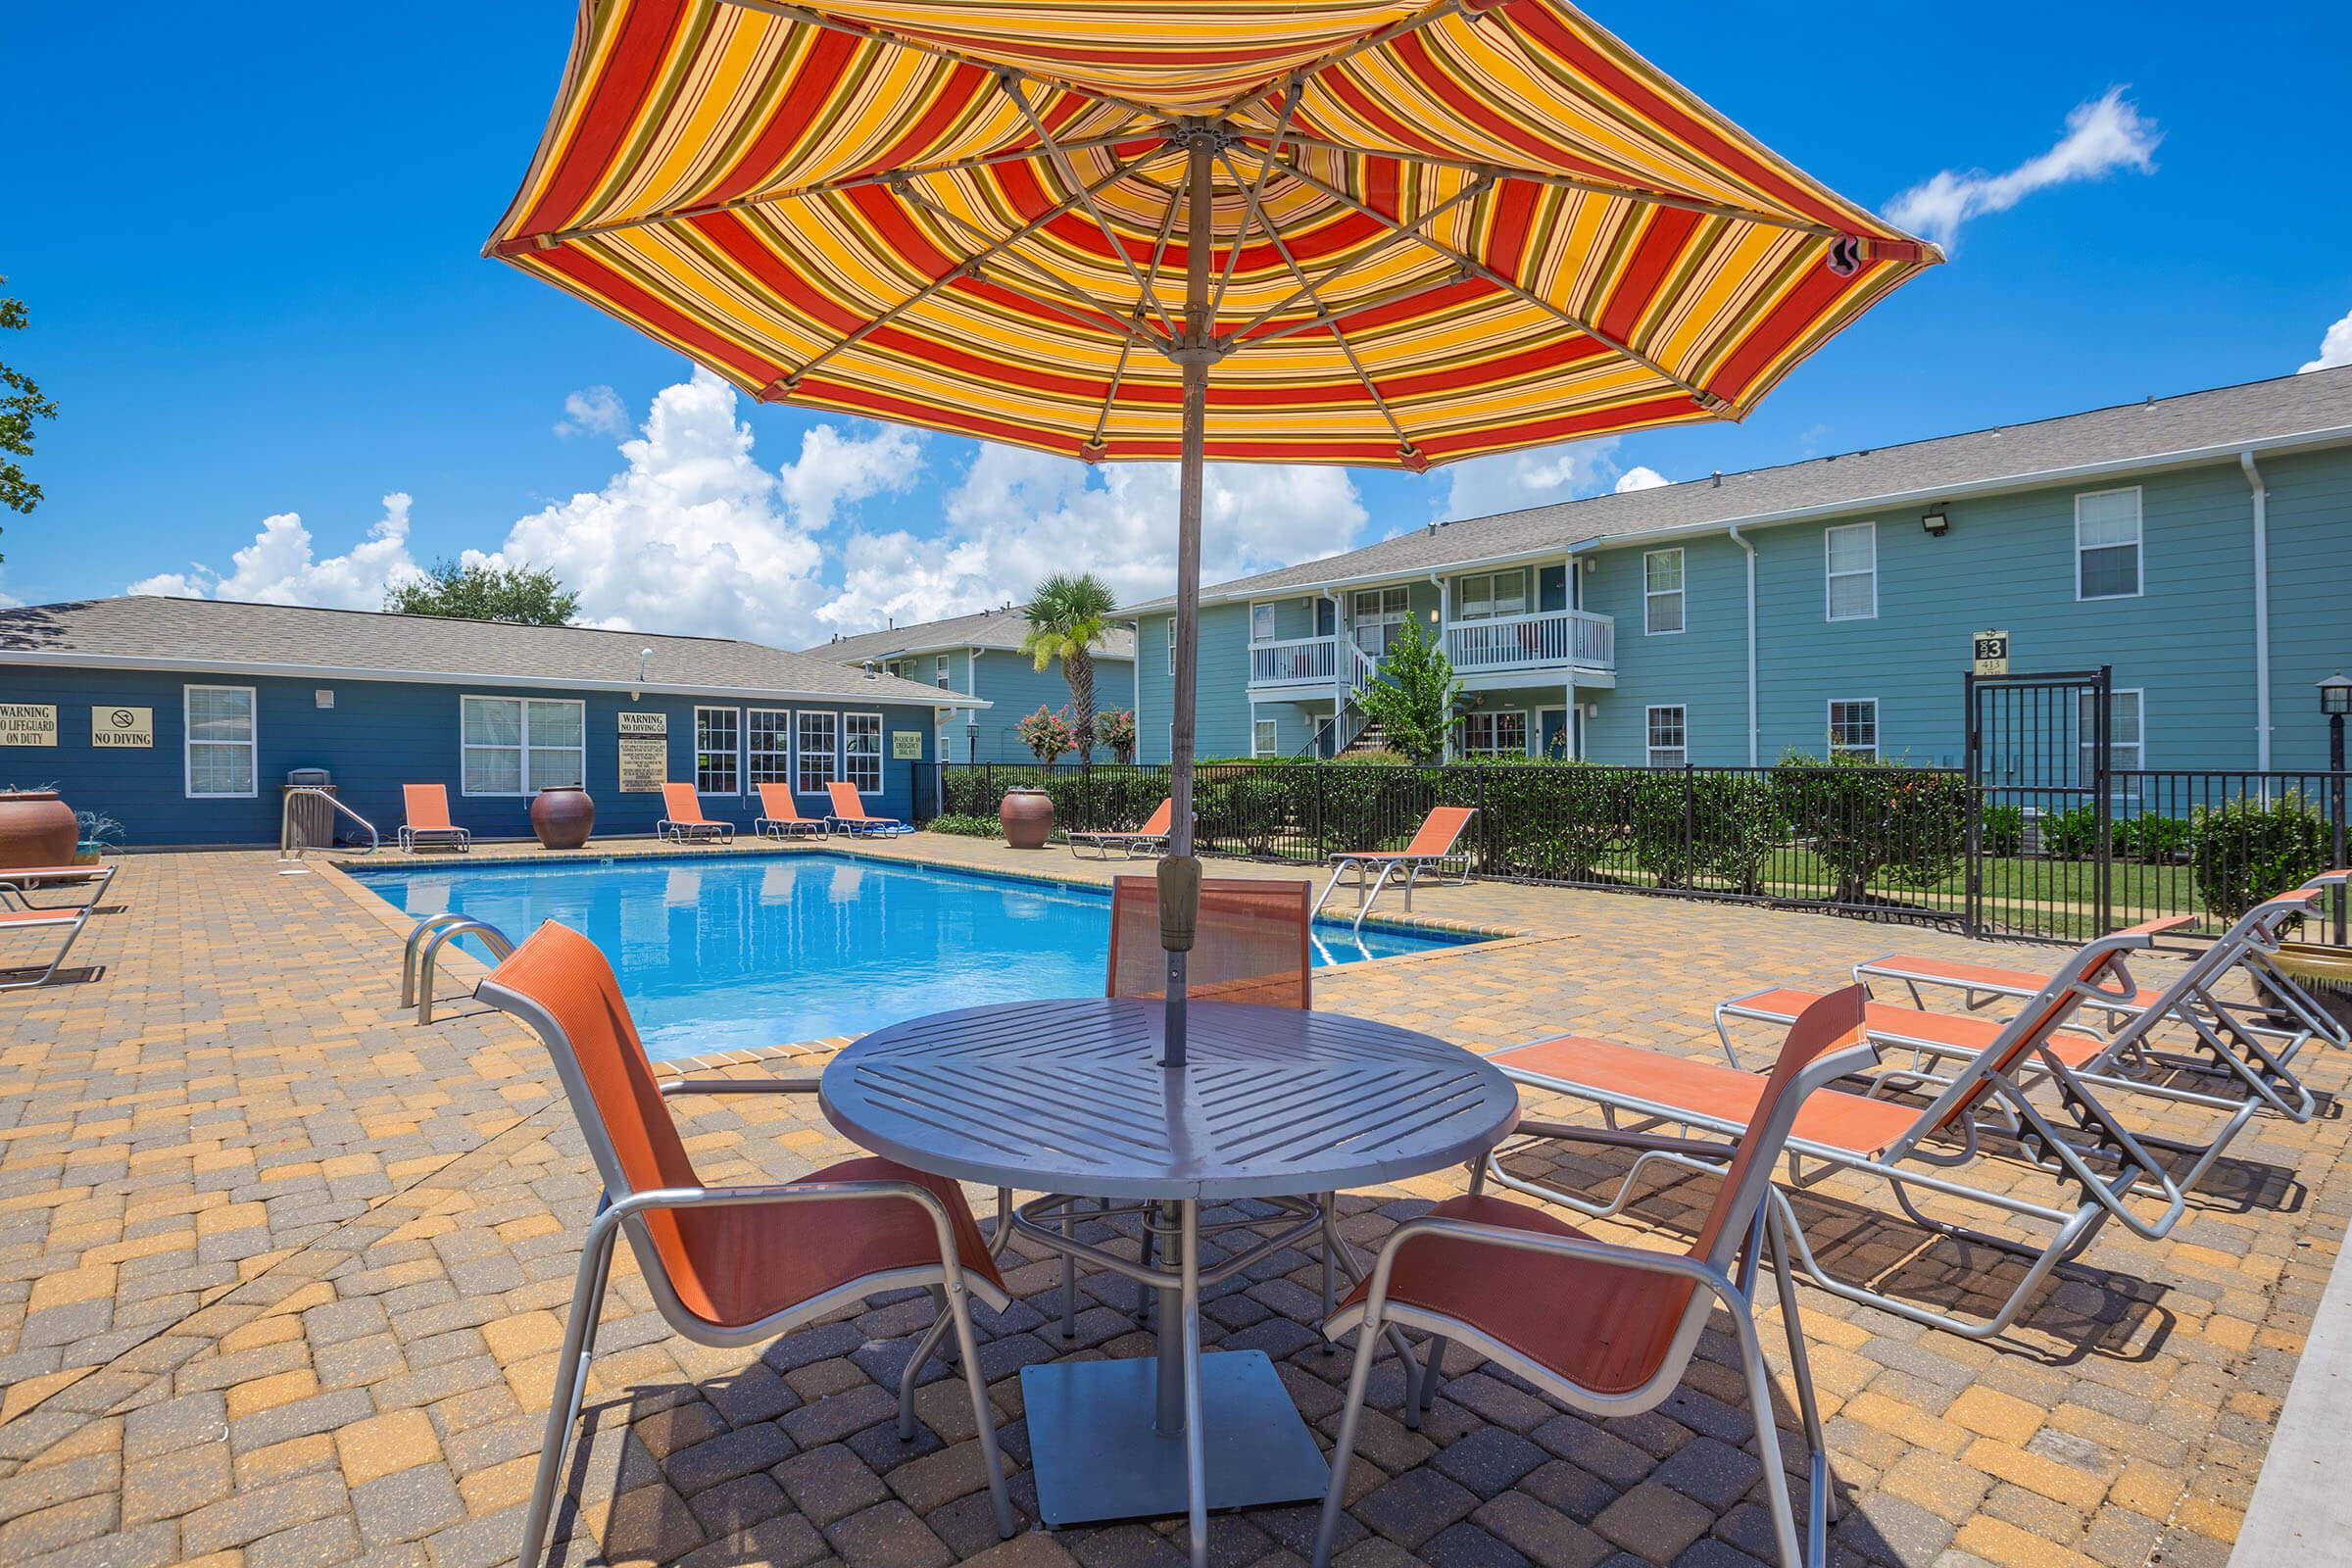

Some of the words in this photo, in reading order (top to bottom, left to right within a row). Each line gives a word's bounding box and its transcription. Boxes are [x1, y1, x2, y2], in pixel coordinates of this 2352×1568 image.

[1980, 640, 1988, 659] BLDG
[1988, 639, 2001, 658] 3
[1982, 660, 2000, 669] 413
[0, 706, 49, 717] WARNING
[622, 714, 662, 724] WARNING
[9, 719, 55, 732] LIFEGUARD
[7, 732, 19, 744] ON
[21, 732, 43, 744] DUTY
[95, 733, 111, 744] NO
[114, 733, 151, 745] DIVING
